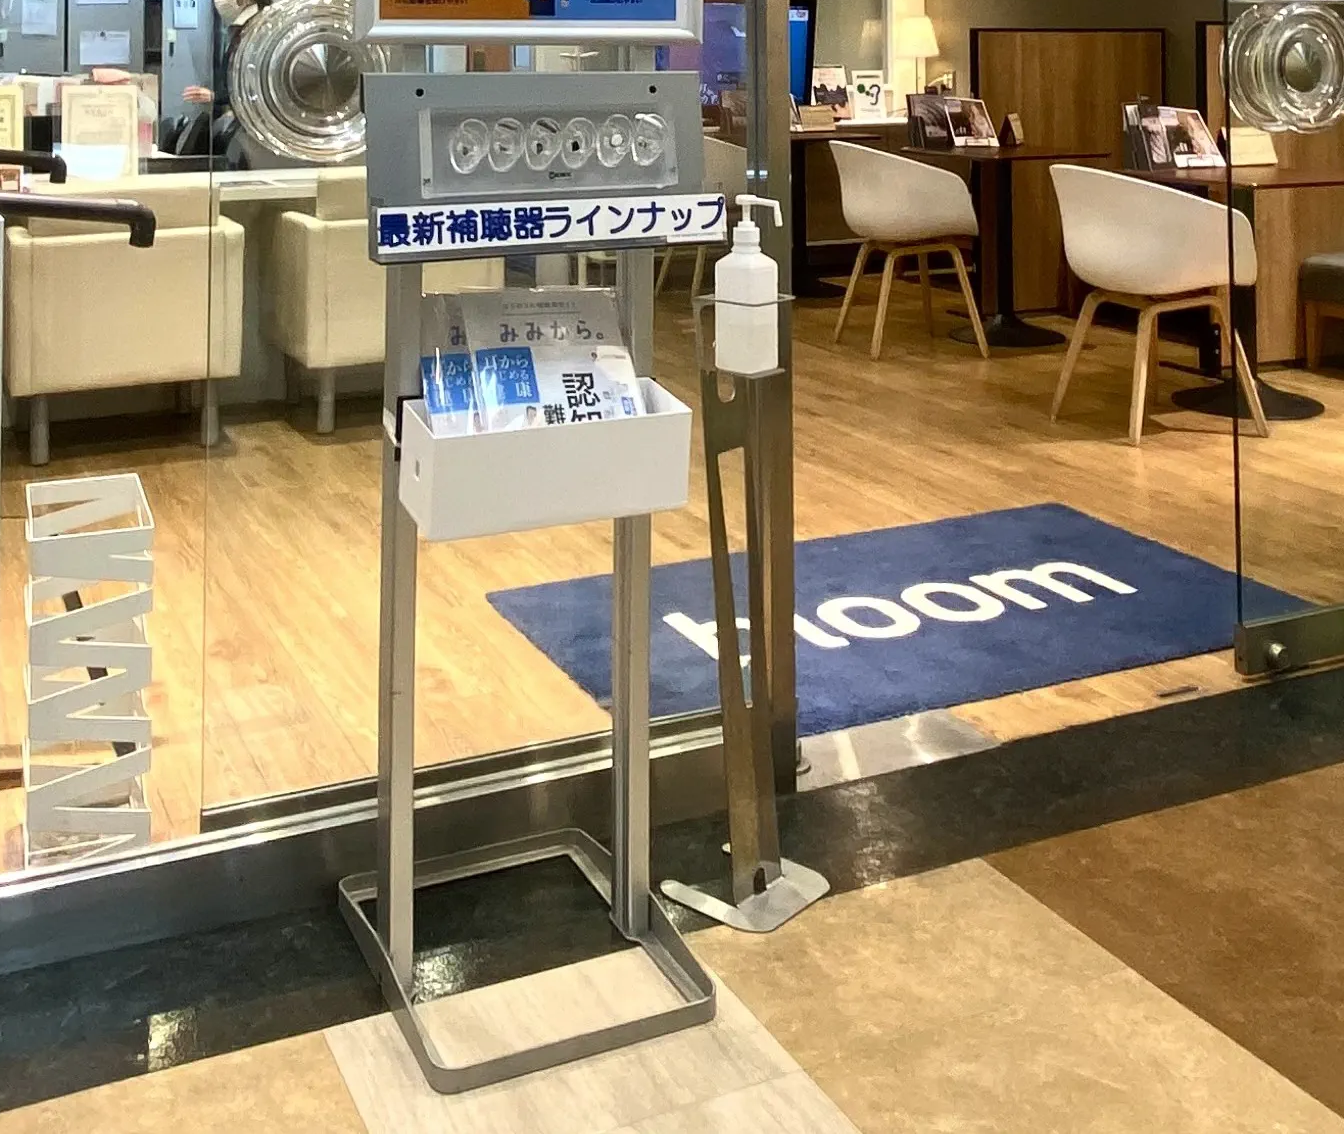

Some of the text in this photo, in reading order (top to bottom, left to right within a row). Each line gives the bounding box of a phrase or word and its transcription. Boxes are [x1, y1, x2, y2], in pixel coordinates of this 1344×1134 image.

[377, 196, 726, 249] 最新補聴器ラインナップ
[499, 320, 605, 343] みみから。
